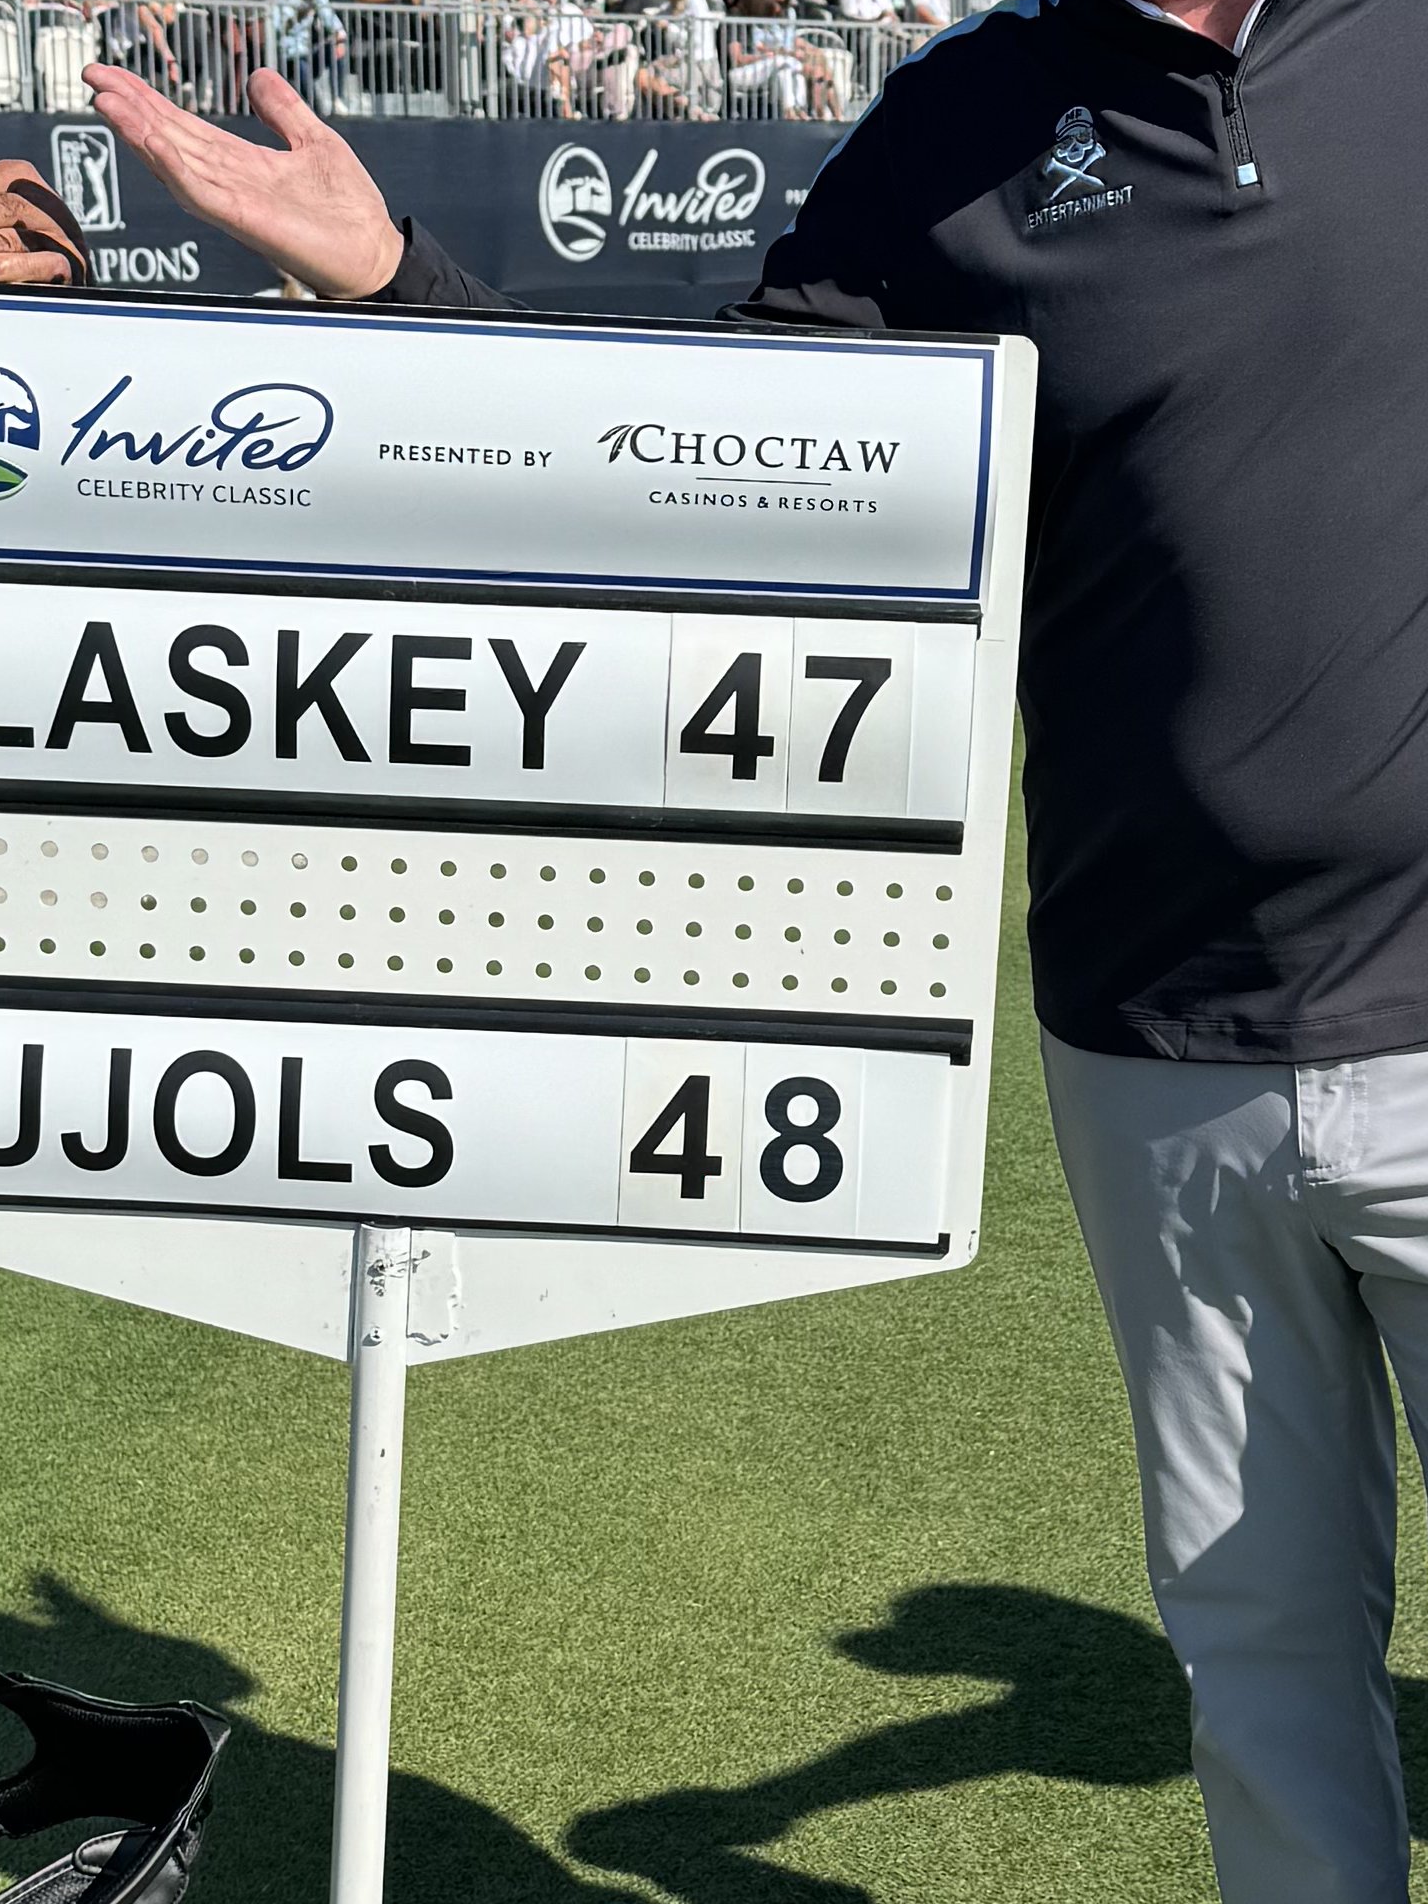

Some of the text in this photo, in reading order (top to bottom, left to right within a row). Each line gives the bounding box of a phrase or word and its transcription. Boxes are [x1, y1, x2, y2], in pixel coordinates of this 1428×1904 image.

[618, 148, 766, 226] Invited
[1028, 185, 1133, 228] ENTERTAINMENT
[89, 240, 201, 283] PIONS
[628, 229, 756, 252] CELEBRITY CLASSIC
[60, 375, 335, 472] Invited
[378, 443, 552, 468] PRESENTED BY
[628, 423, 901, 474] CHOCTAW
[77, 477, 312, 507] CELEBRITY CLASSIC
[648, 490, 878, 514] CASINOS & RESORTS
[678, 651, 894, 783] 47
[628, 1073, 845, 1205] 48
